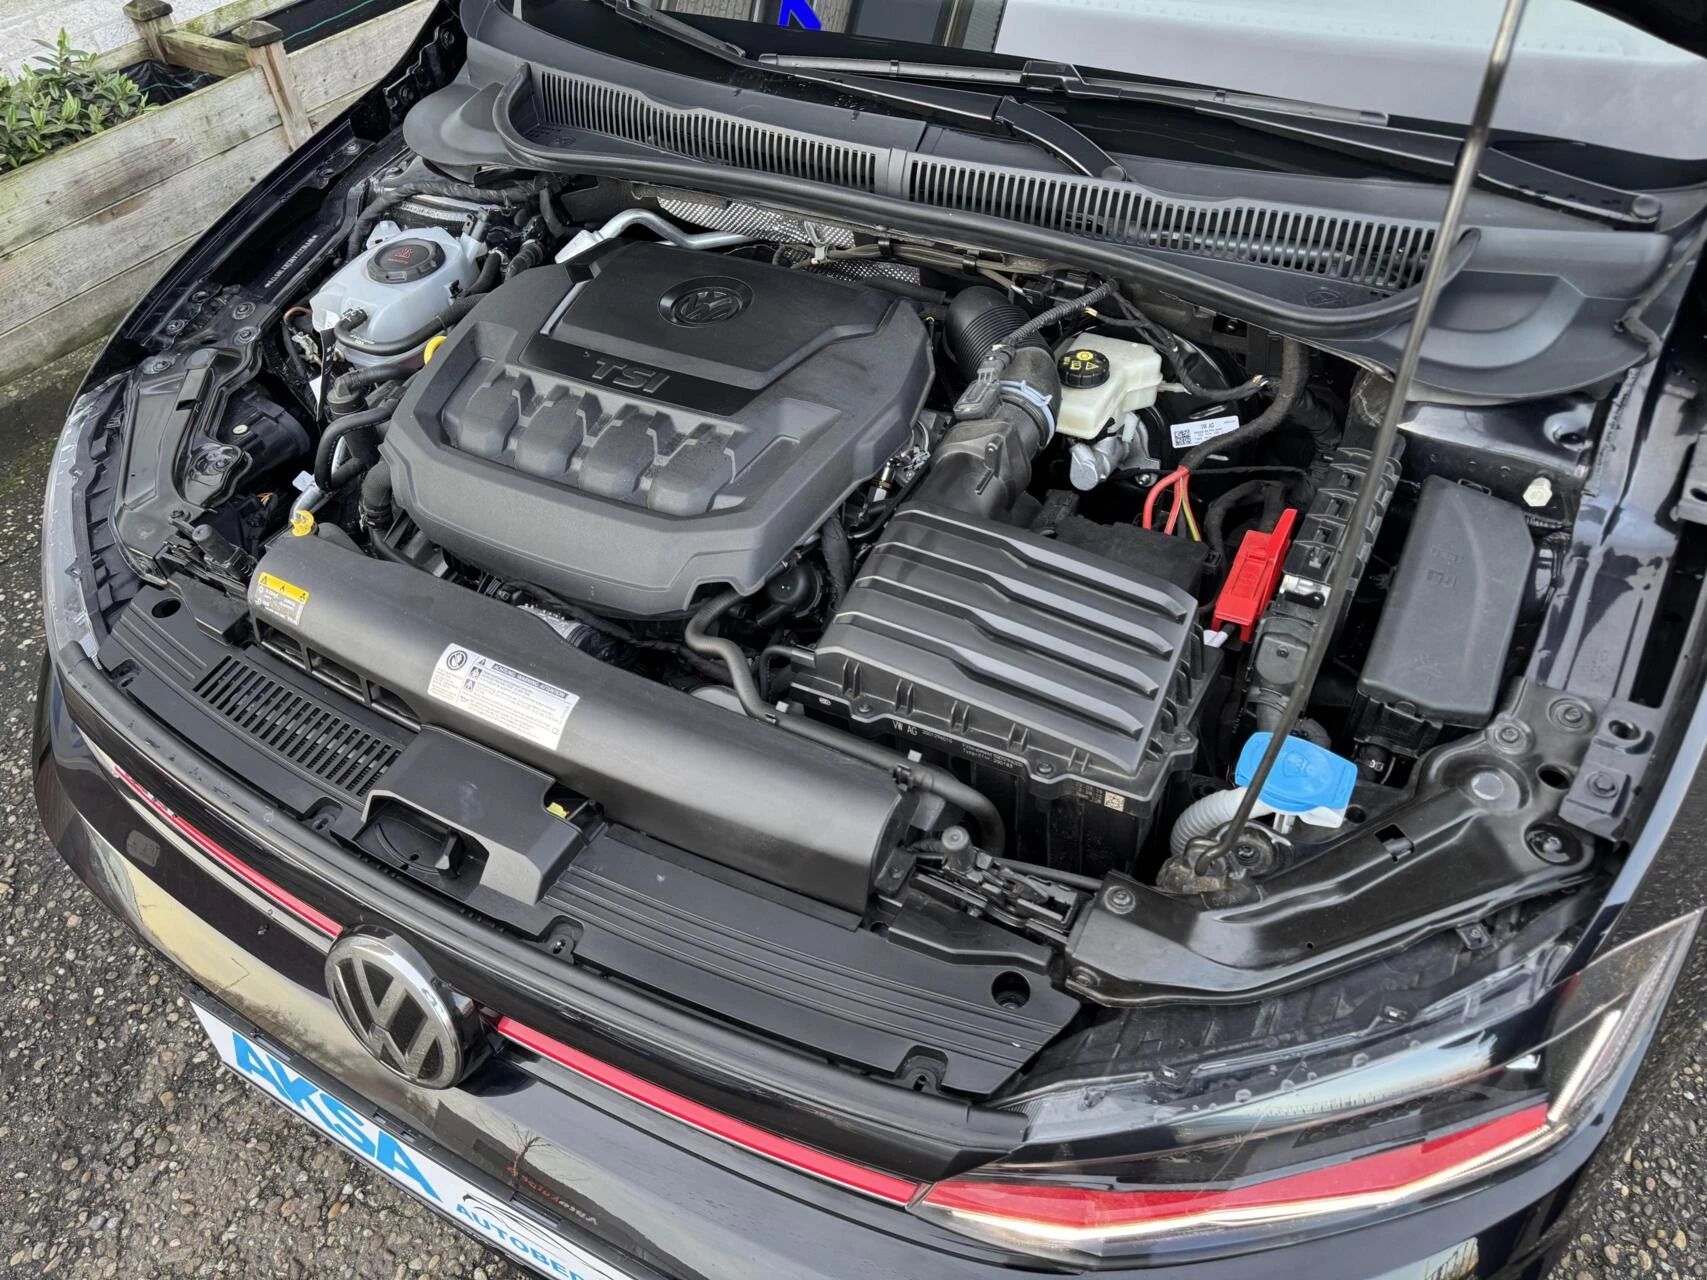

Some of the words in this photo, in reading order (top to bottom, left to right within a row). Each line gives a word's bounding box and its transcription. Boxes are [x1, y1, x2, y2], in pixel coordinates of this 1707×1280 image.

[591, 358, 671, 394] TSI
[892, 719, 904, 732] VW
[906, 725, 919, 737] AG
[232, 1031, 441, 1203] AKSA
